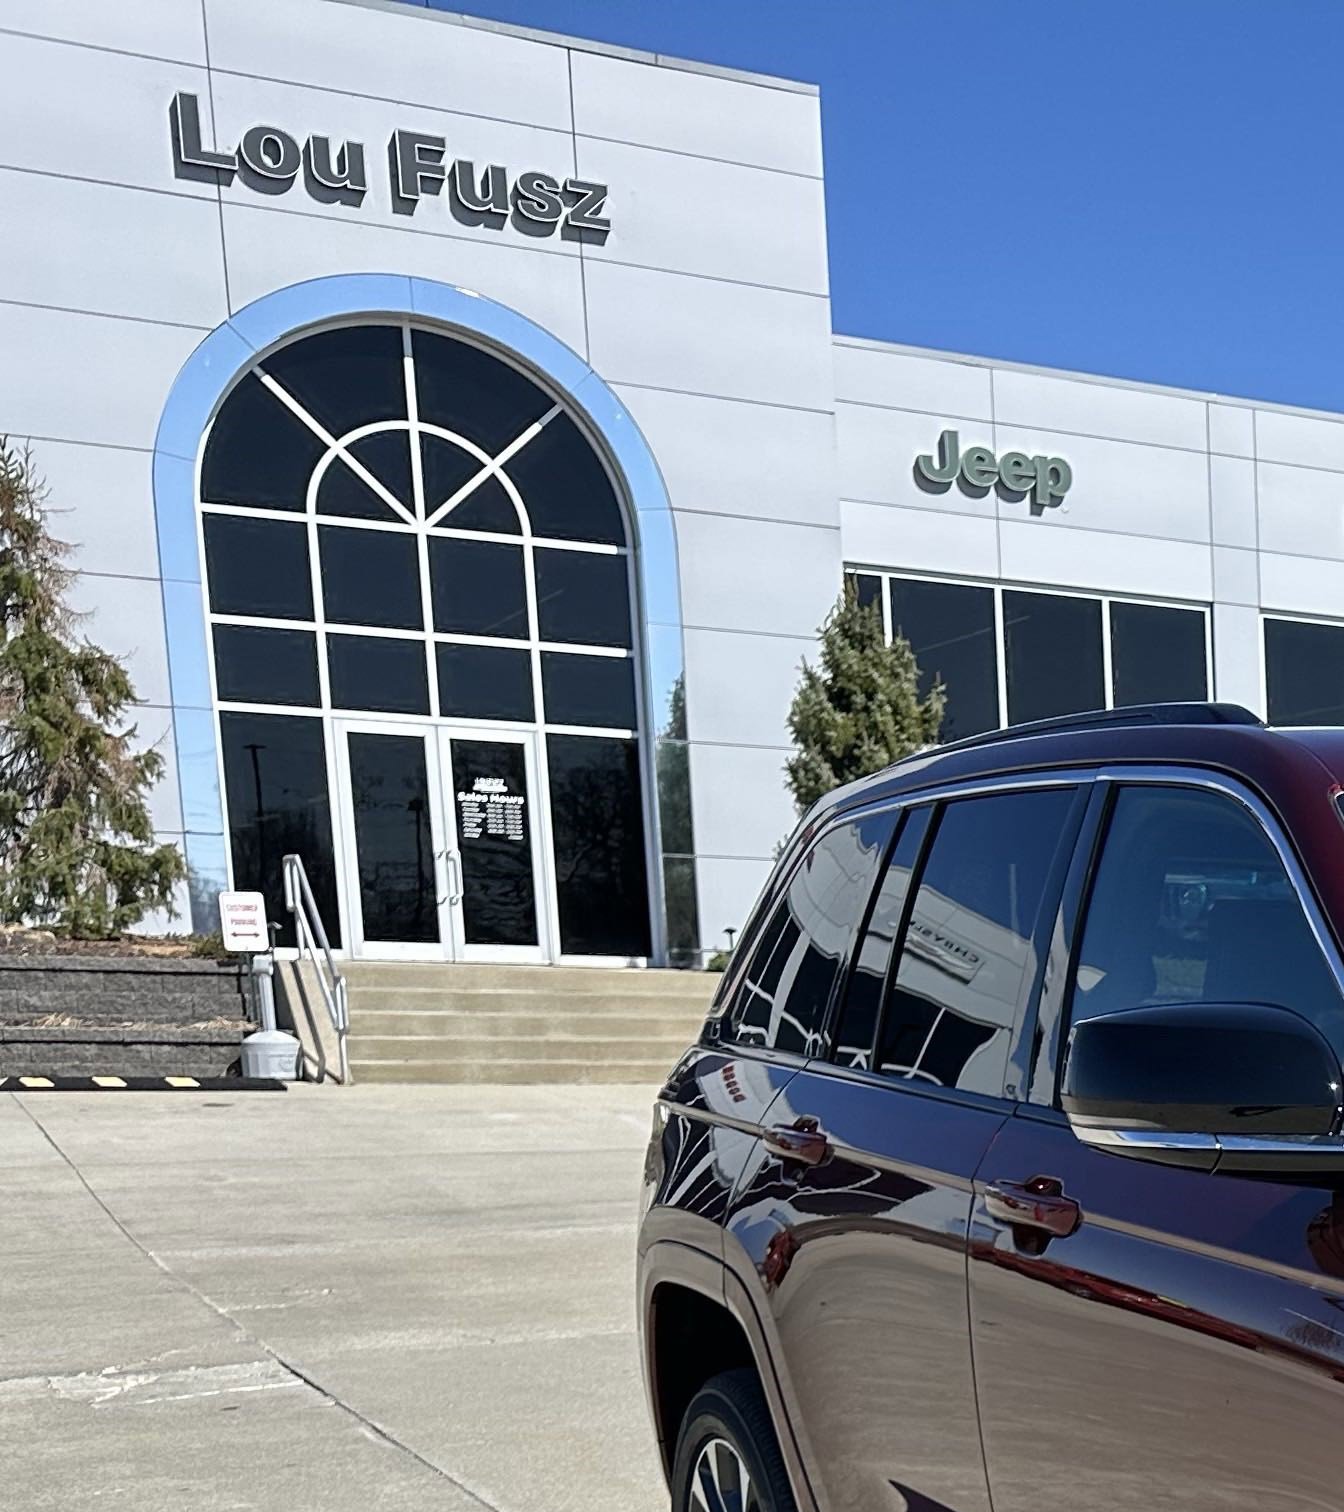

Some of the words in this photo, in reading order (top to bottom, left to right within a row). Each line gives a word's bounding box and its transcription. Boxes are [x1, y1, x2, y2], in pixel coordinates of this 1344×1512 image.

[170, 91, 367, 200] Lou
[388, 128, 612, 238] Fusz
[914, 429, 1072, 510] Jeep
